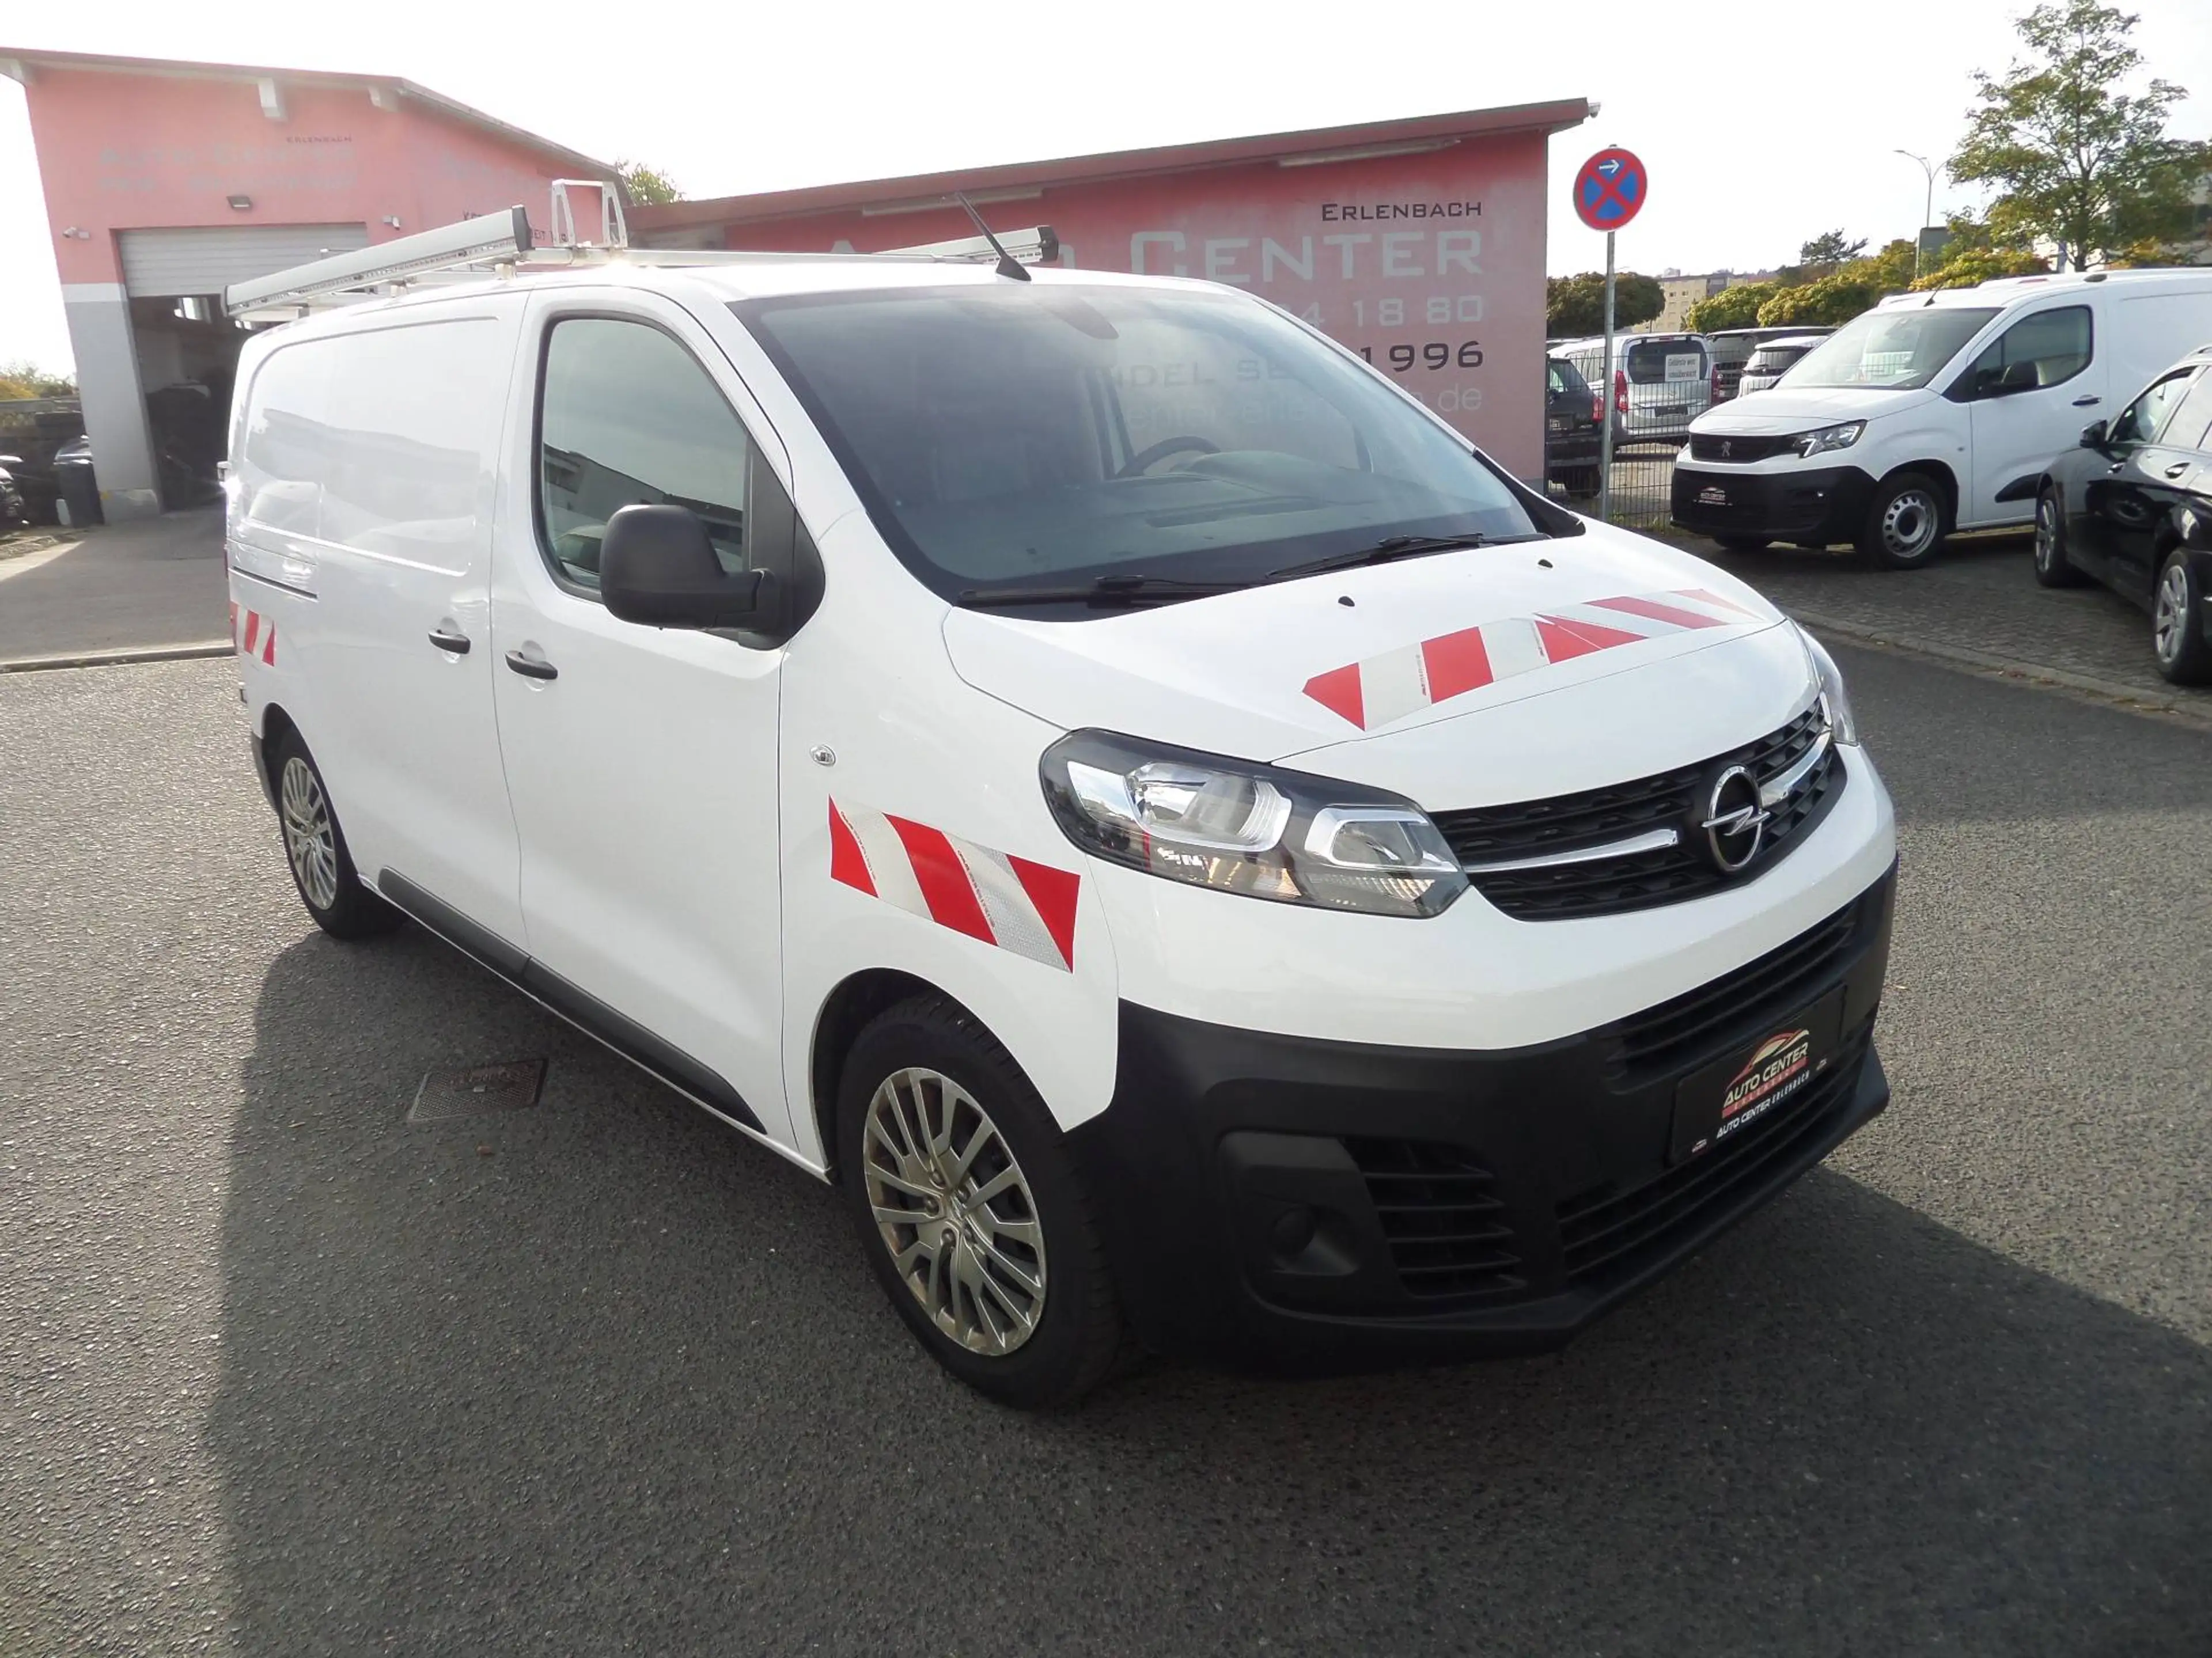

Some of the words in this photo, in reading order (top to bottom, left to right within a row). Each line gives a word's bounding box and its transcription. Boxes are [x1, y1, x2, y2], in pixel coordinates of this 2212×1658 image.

[1321, 202, 1482, 221] ERLENBACH
[1130, 229, 1483, 283] CENTER
[1353, 298, 1404, 327] 18
[1427, 295, 1482, 324] 80
[1360, 341, 1483, 372] 1996
[1722, 1073, 1760, 1108] AUTO
[1762, 1042, 1809, 1082] CENTER
[1716, 1118, 1740, 1139] AUTO
[1741, 1099, 1771, 1123] CENTER
